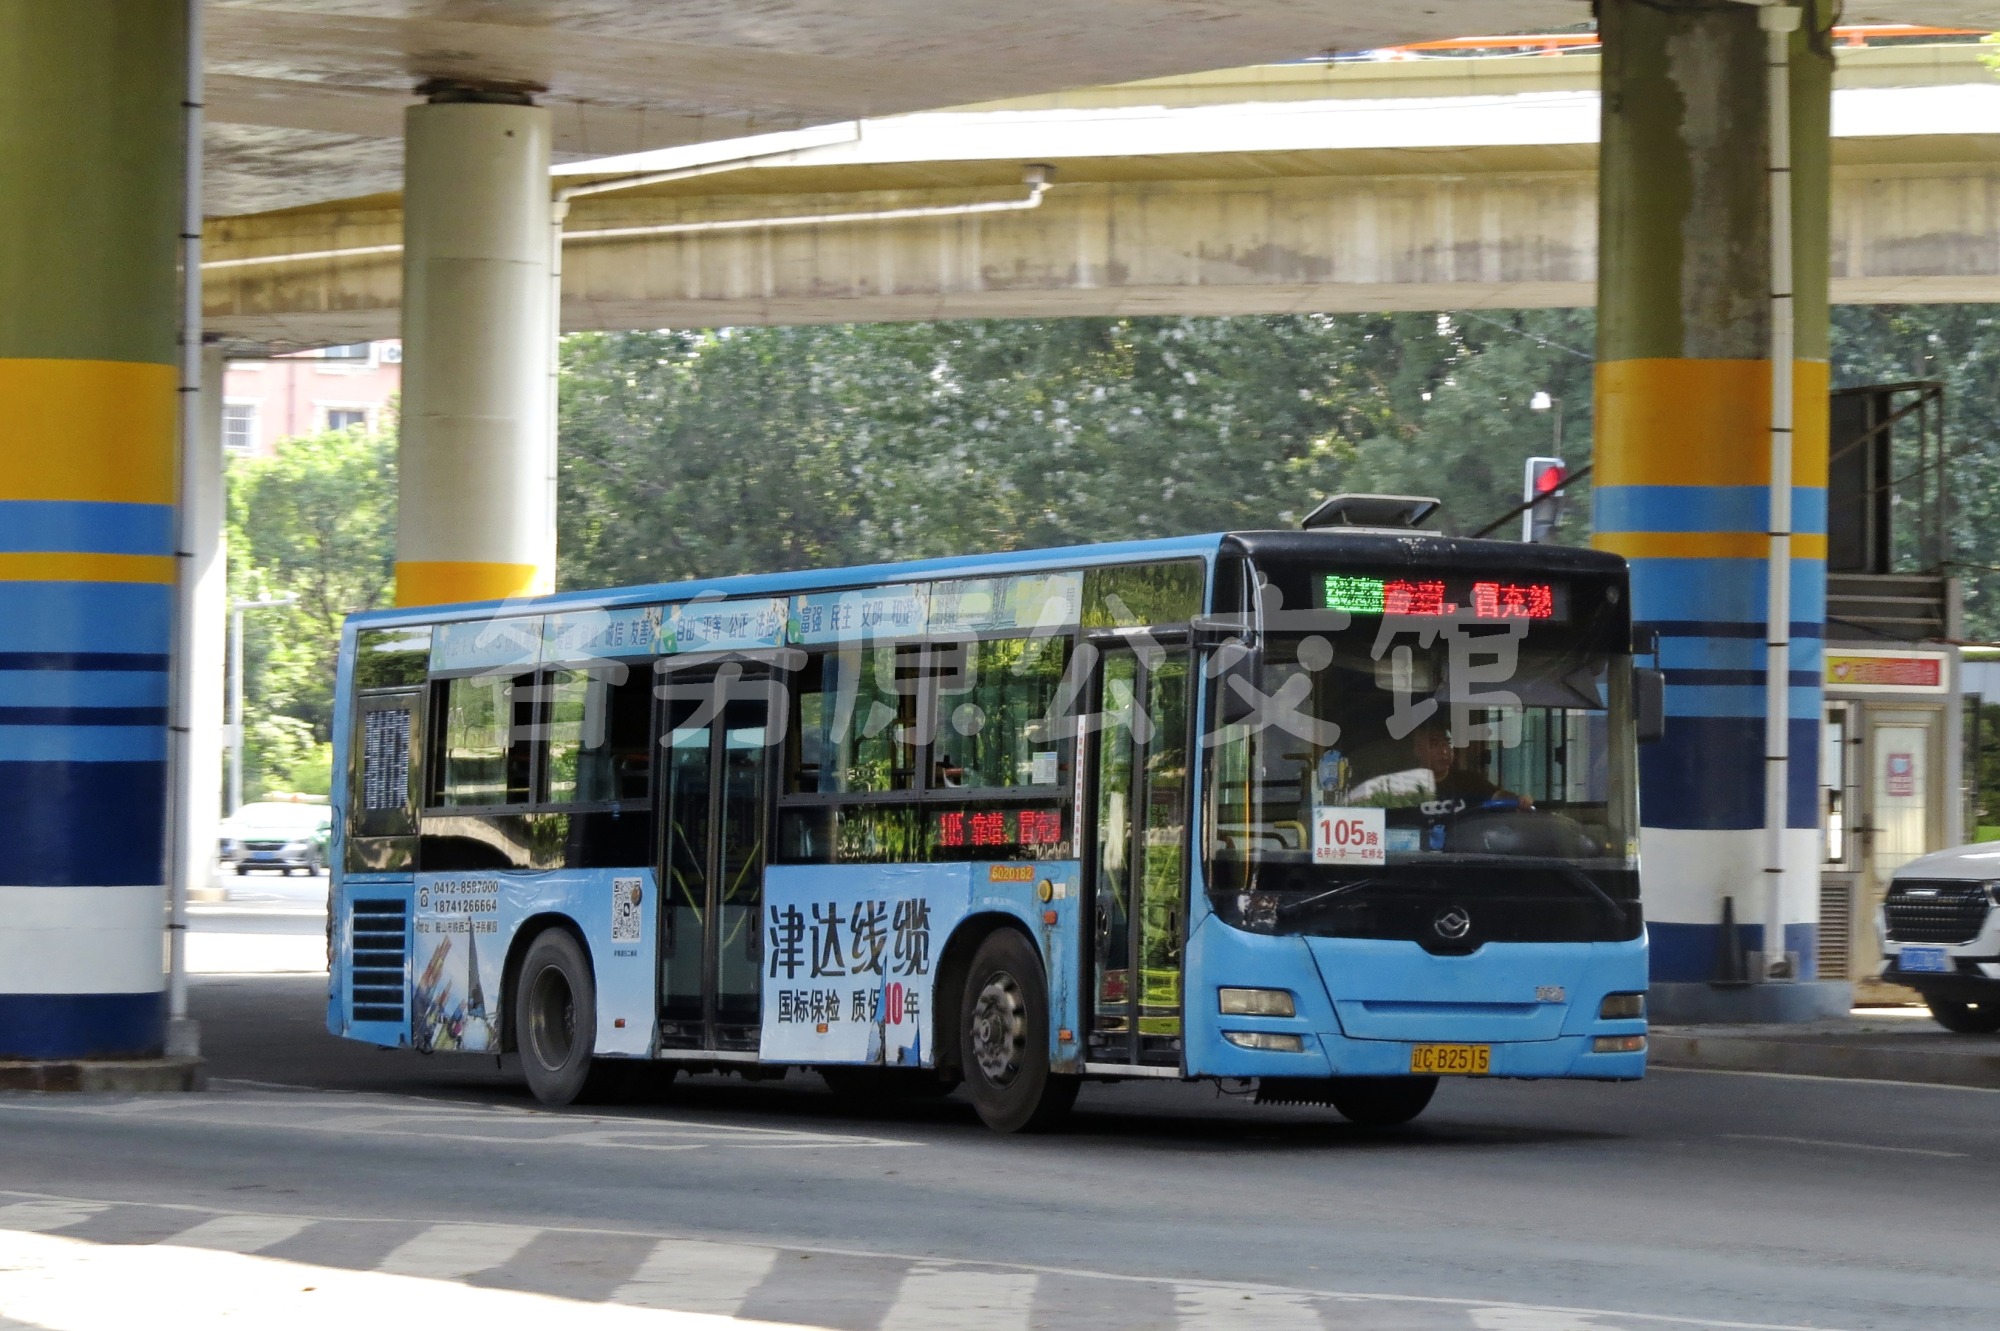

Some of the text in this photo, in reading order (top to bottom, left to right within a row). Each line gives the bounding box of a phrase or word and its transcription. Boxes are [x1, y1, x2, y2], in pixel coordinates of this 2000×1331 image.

[630, 619, 650, 646] 友善
[676, 610, 776, 642] 自由 平等 公正 法治
[800, 605, 822, 633] 富强
[830, 603, 852, 630] 民主
[861, 600, 883, 628] 文明
[1320, 819, 1378, 846] 105路
[991, 865, 1032, 880] 6020182
[769, 898, 931, 980] 津达线缆
[778, 988, 841, 1024] 国标保检
